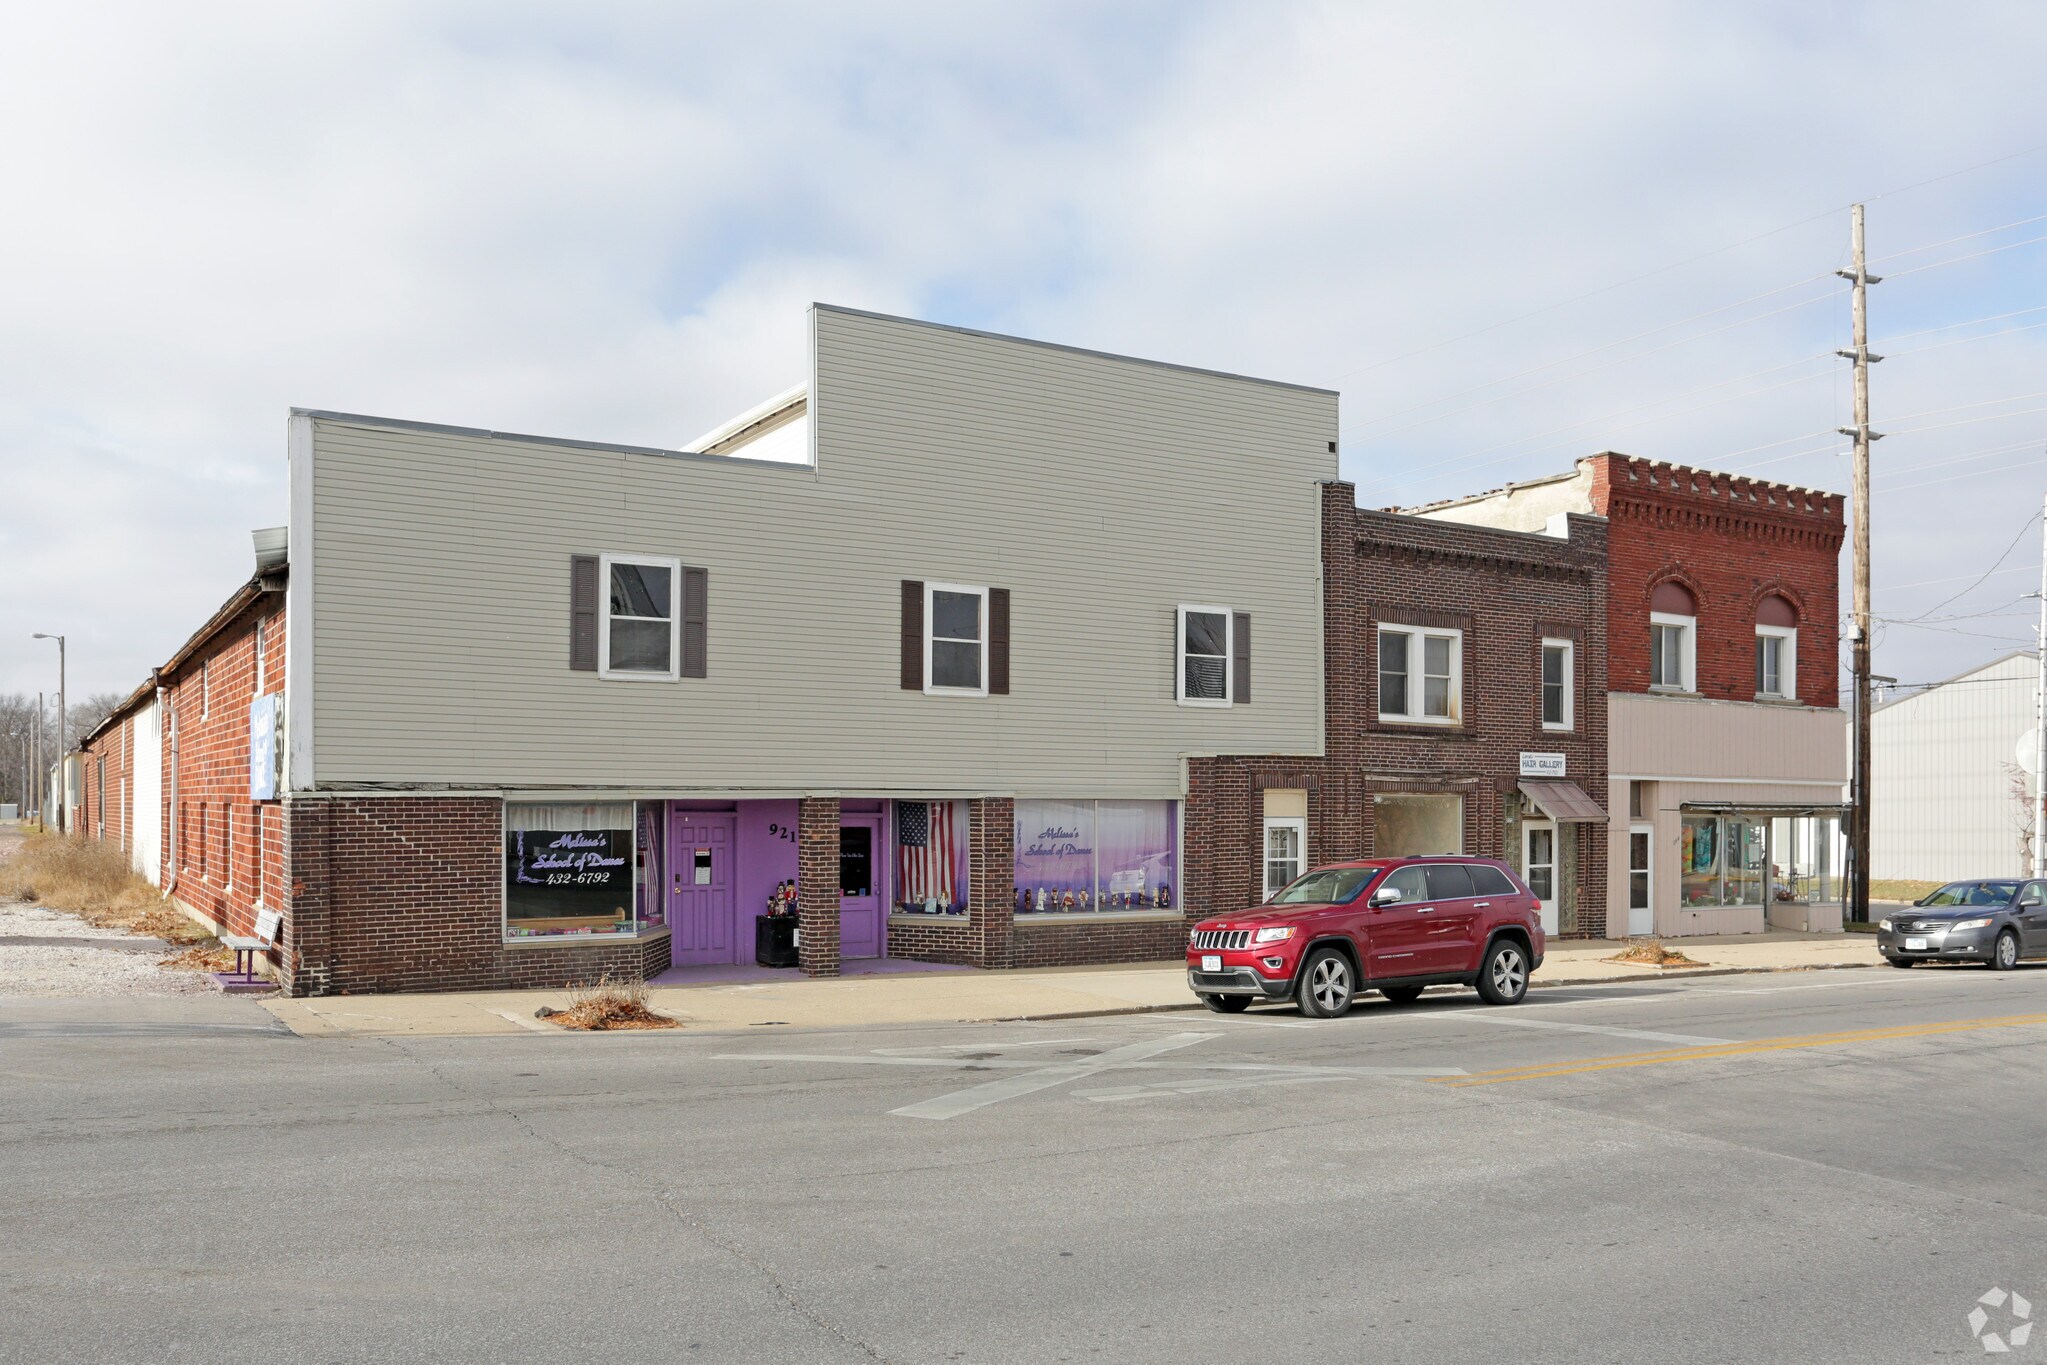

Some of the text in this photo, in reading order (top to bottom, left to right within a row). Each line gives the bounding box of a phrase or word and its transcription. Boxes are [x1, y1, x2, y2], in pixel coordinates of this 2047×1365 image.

[1522, 760, 1563, 769] HAIR GALLERY
[769, 823, 797, 843] 921
[1025, 843, 1056, 856] School
[1055, 843, 1065, 860] of
[531, 852, 625, 872] School of Dance
[545, 871, 610, 885] 432-6792
